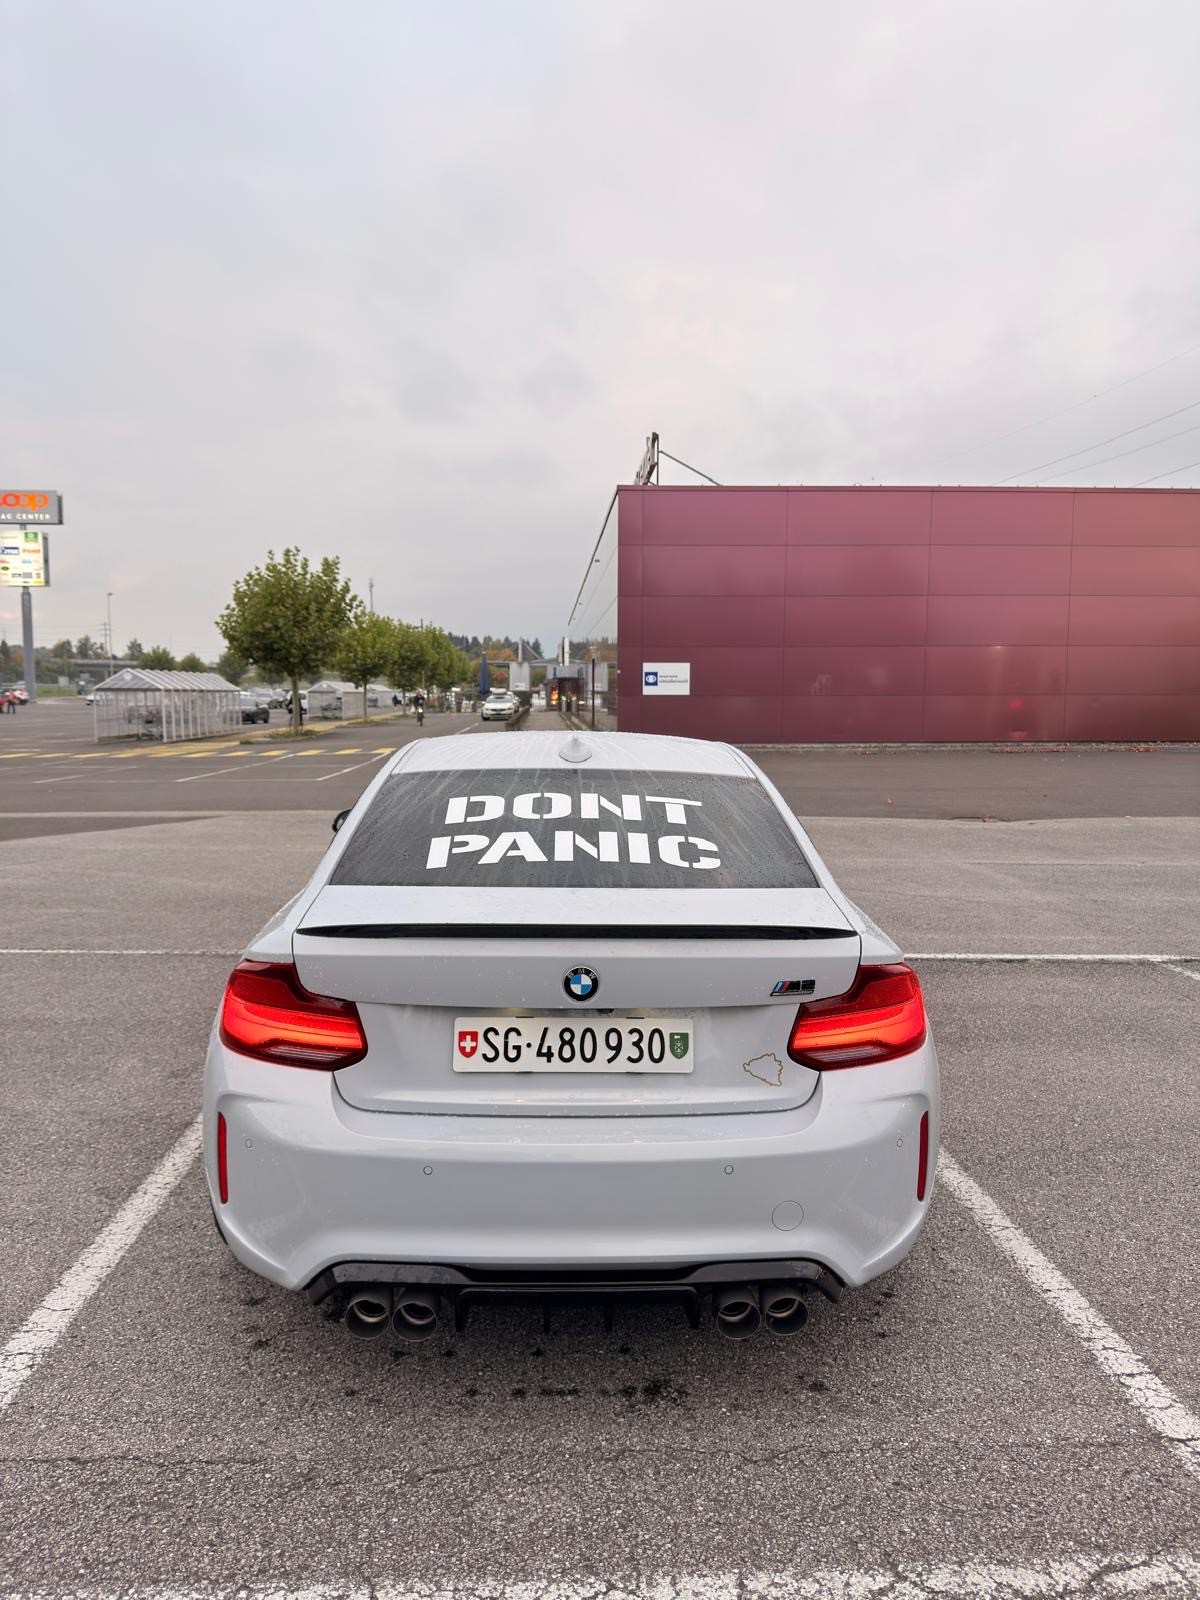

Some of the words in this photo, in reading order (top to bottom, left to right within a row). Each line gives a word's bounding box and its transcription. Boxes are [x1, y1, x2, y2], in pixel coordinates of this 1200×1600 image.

[15, 513, 50, 521] CENTER
[444, 792, 702, 825] DONT
[425, 830, 721, 870] PANIC
